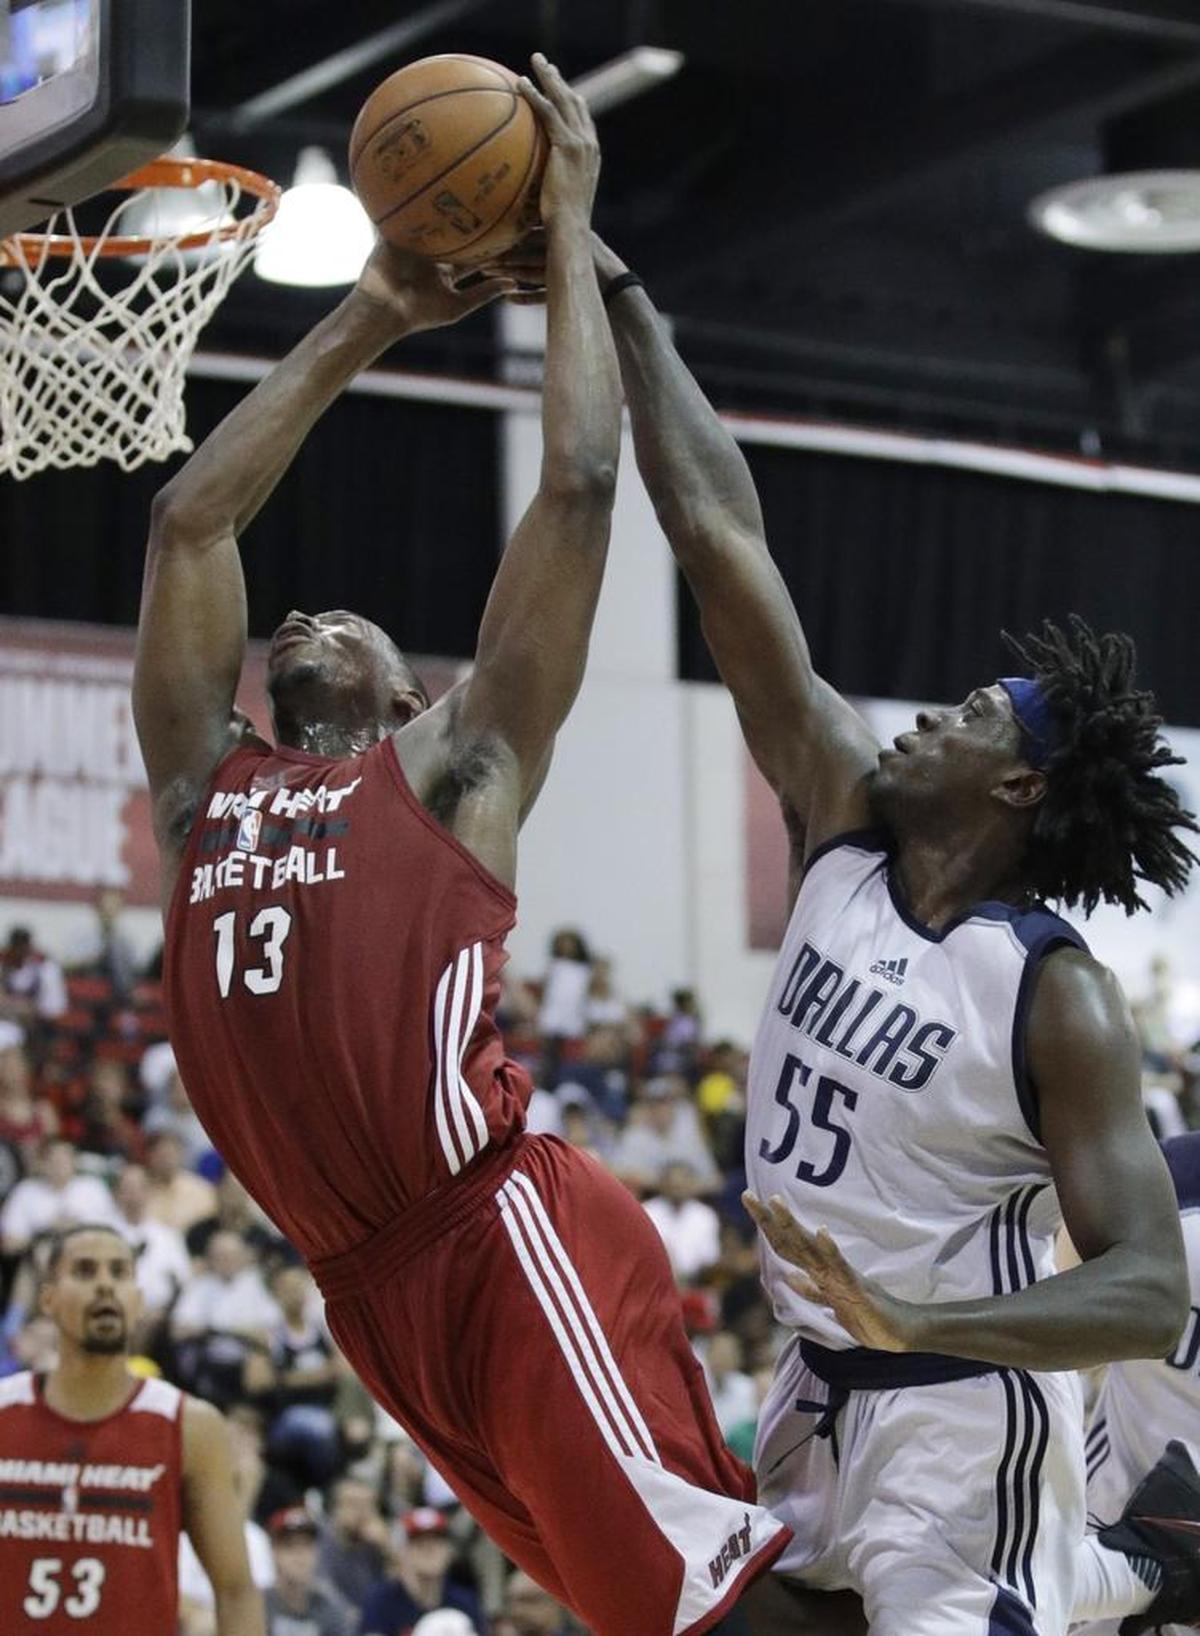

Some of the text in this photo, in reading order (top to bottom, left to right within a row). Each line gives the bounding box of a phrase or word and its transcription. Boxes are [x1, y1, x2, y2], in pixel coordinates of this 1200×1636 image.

[269, 776, 362, 818] HEAT
[213, 906, 292, 998] 13
[775, 936, 960, 1092] DALLAS
[759, 1052, 859, 1187] 55
[80, 1463, 166, 1492] HEAT
[0, 1509, 153, 1548] ASKETBALL
[708, 1512, 752, 1589] HEAT
[23, 1557, 106, 1620] 53
